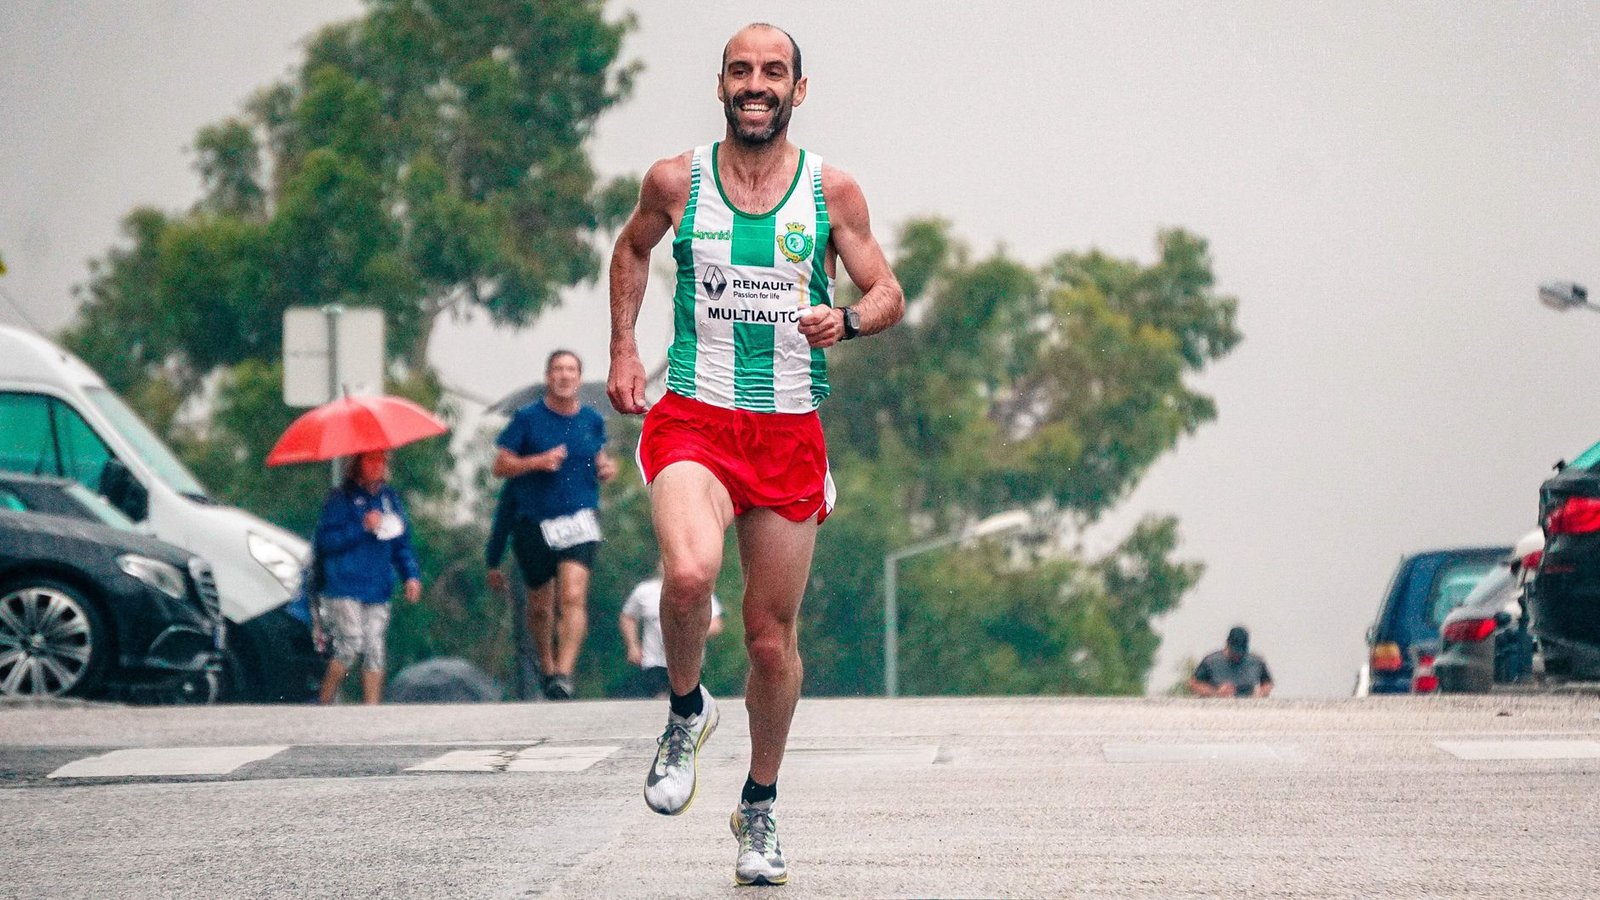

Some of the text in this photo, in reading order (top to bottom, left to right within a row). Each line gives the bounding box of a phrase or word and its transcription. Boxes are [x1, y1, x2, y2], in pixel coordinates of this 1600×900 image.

[733, 280, 794, 291] RENAULT
[733, 291, 758, 299] Passion
[770, 292, 780, 300] life
